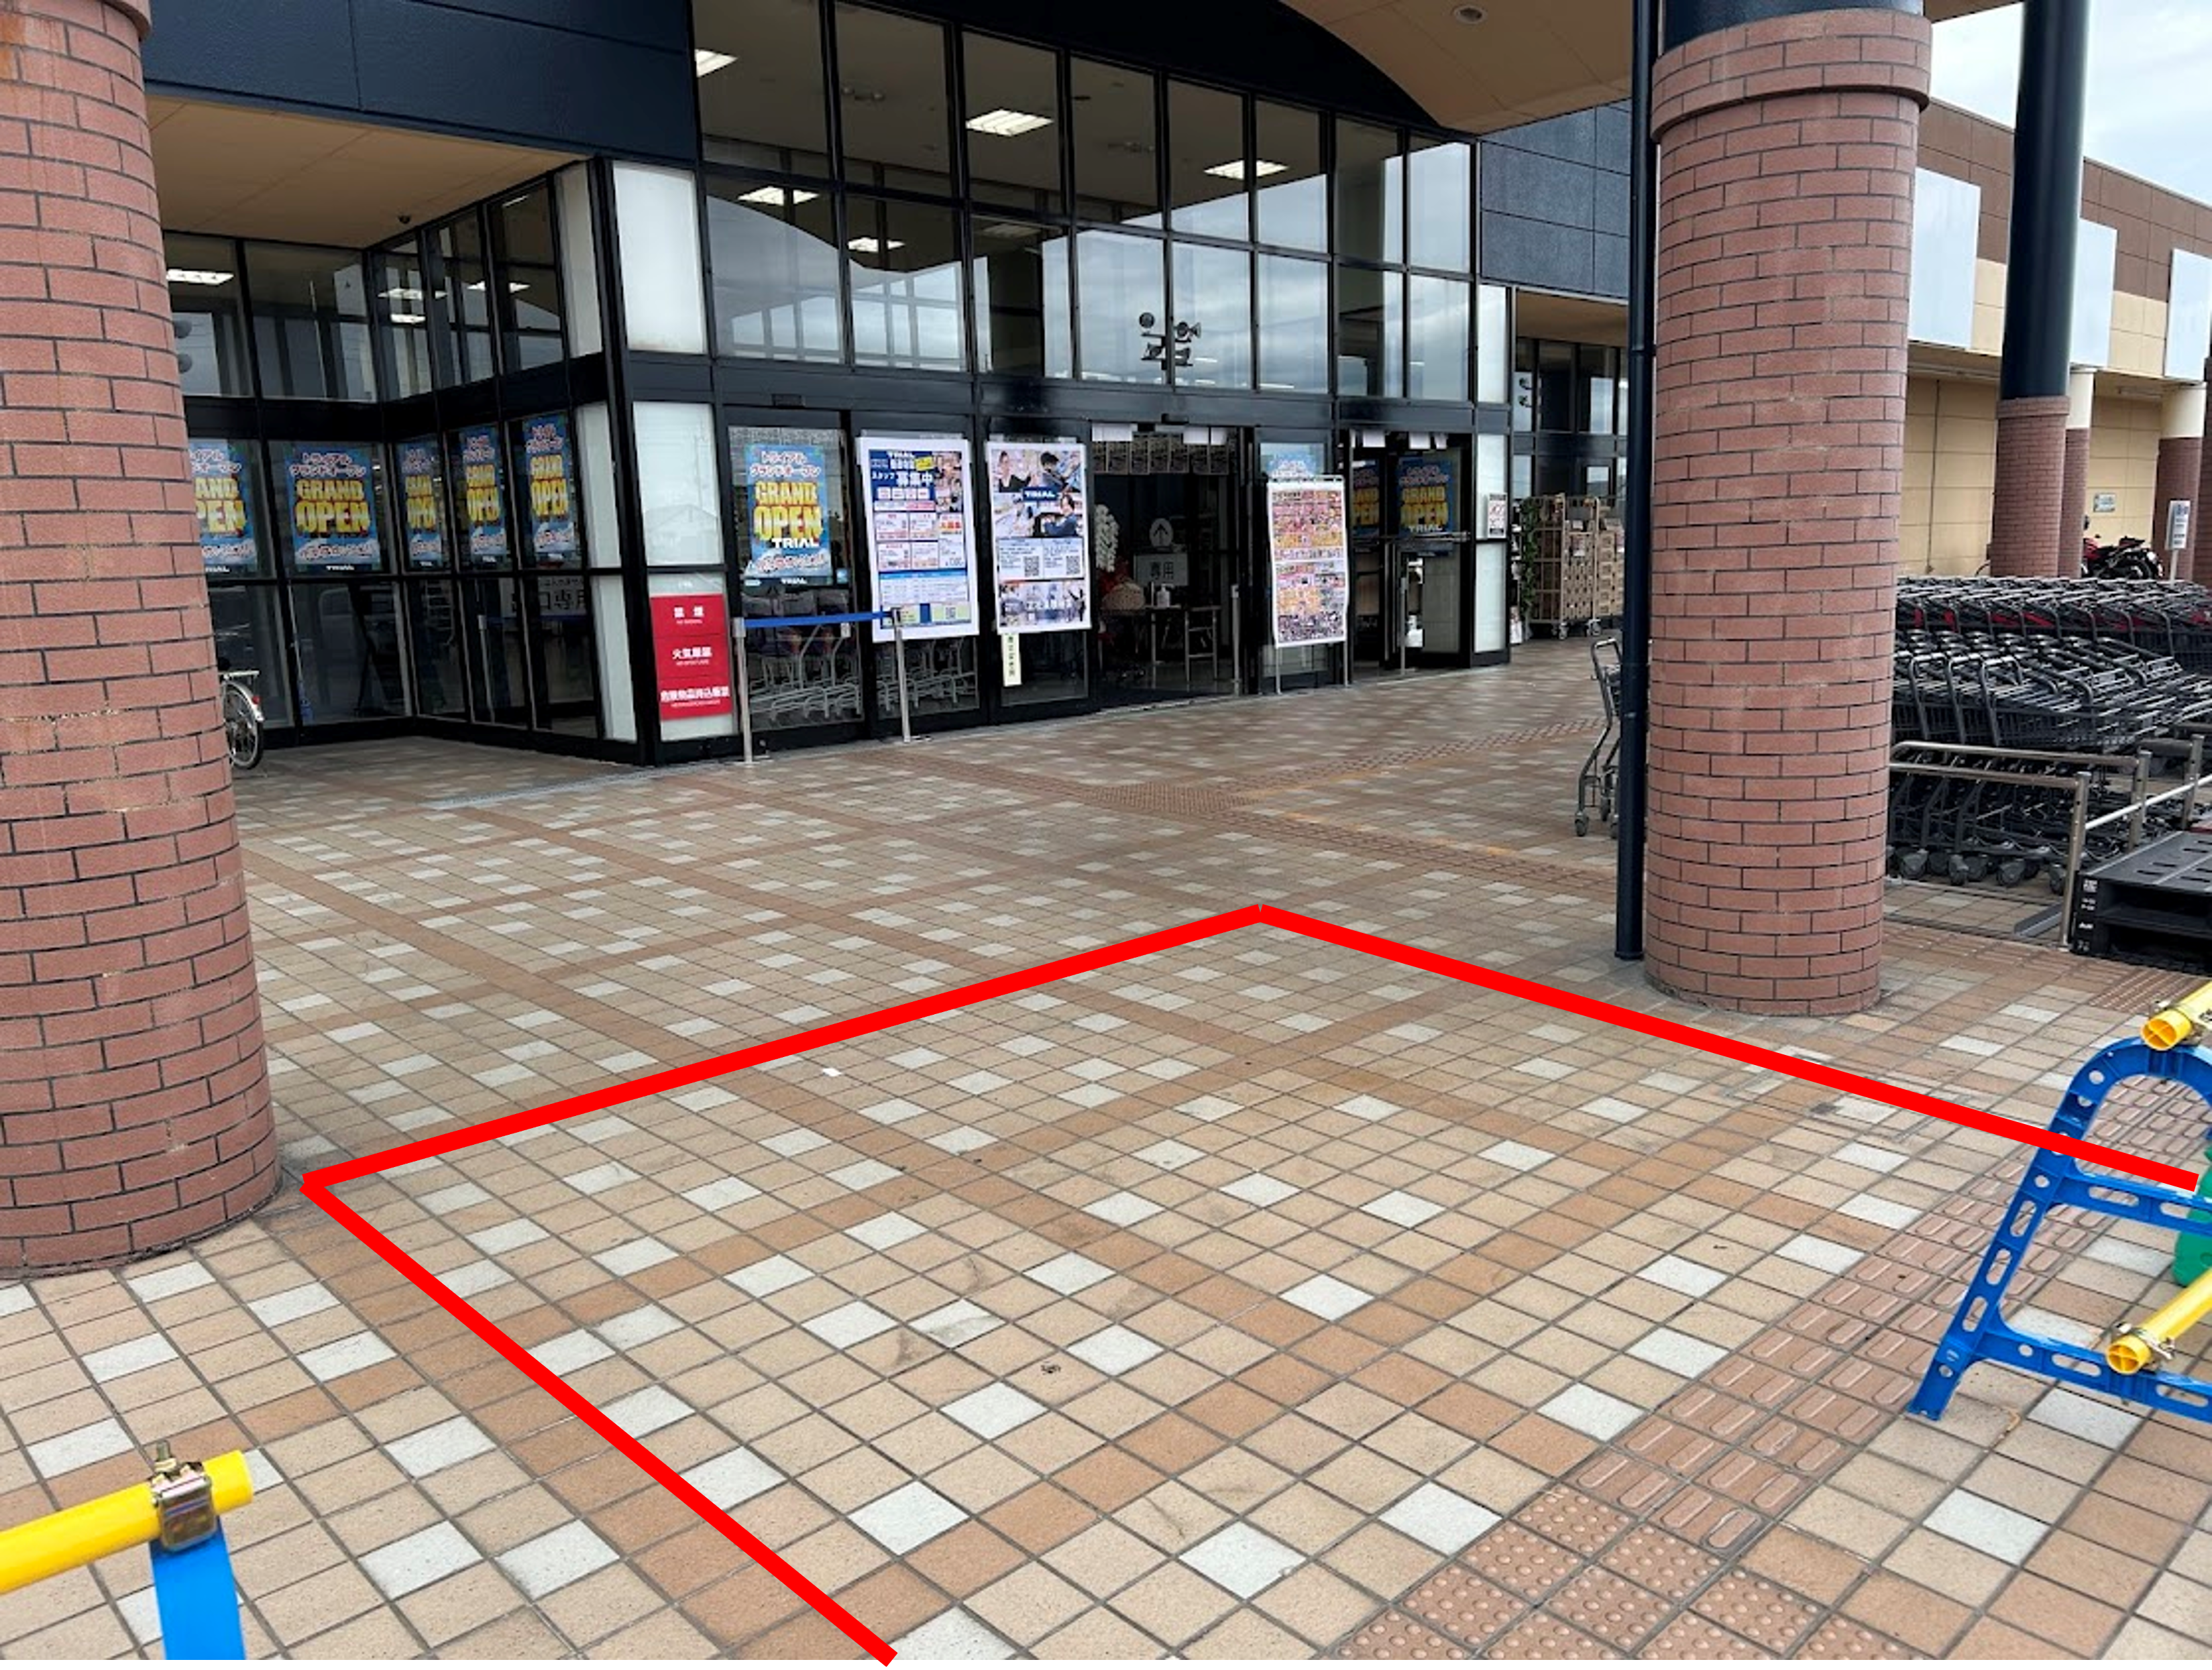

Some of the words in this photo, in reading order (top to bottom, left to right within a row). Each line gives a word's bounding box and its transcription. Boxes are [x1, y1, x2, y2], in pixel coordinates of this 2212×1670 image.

[195, 478, 239, 498] AND
[296, 480, 363, 499] GRAND
[756, 481, 818, 504] GRAND
[197, 500, 246, 533] PEN
[296, 501, 370, 533] OPEN
[754, 505, 823, 541] OPEN
[771, 538, 820, 549] TRIAL
